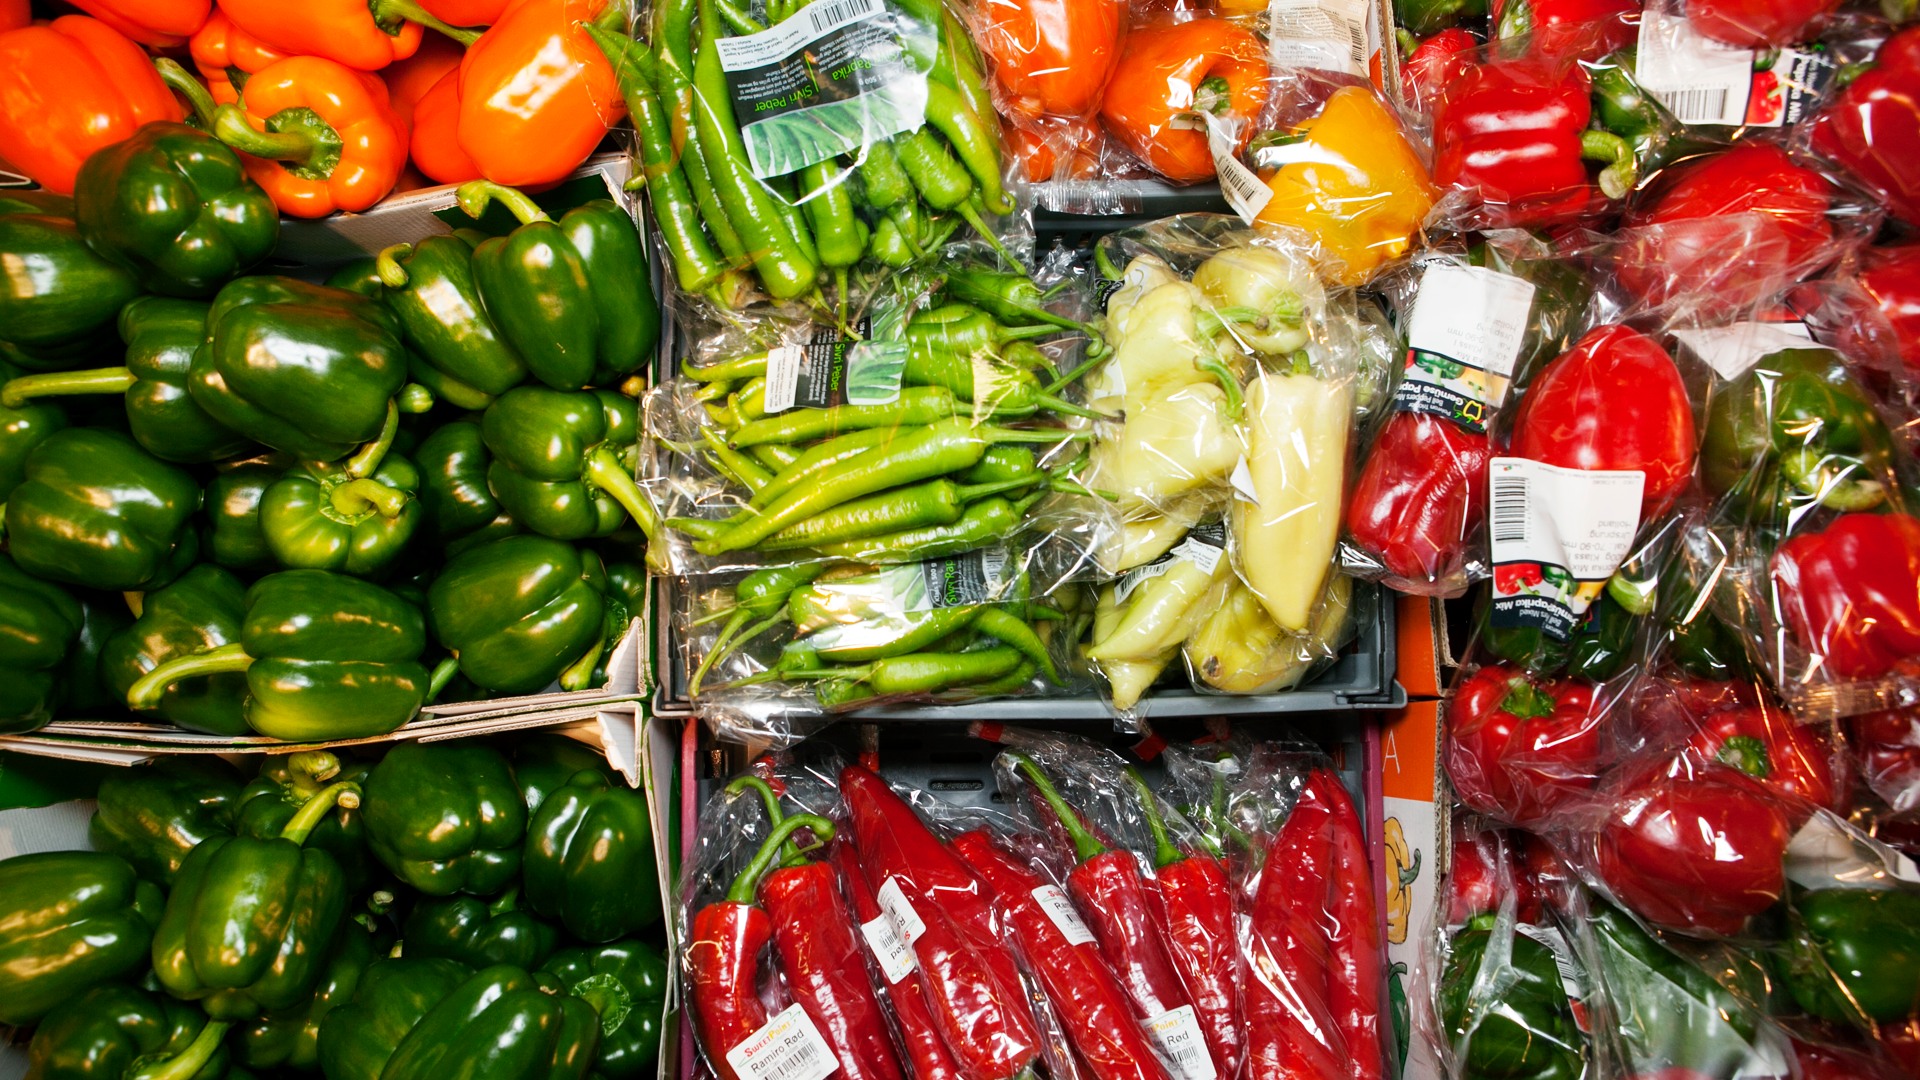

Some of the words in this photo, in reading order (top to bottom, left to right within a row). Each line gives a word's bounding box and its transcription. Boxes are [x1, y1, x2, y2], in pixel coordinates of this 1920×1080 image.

[831, 59, 872, 80] Paprika
[864, 75, 876, 84] 500
[788, 84, 812, 103] Sivri
[753, 95, 786, 112] Peber
[1786, 101, 1801, 124] Mix
[1446, 327, 1462, 336] mm
[833, 343, 844, 363] Sivri
[830, 365, 841, 390] Peber
[1422, 385, 1463, 405] Gemüse
[1431, 397, 1443, 406] Bell
[1430, 404, 1450, 416] Poivron
[1495, 600, 1513, 610] Mix
[1515, 598, 1552, 611] Paprika
[1548, 616, 1561, 626] Bell
[1382, 729, 1400, 774] A
[1166, 1030, 1189, 1045] Rød
[750, 1045, 784, 1074] Ramiro
[784, 1029, 804, 1047] Rød
